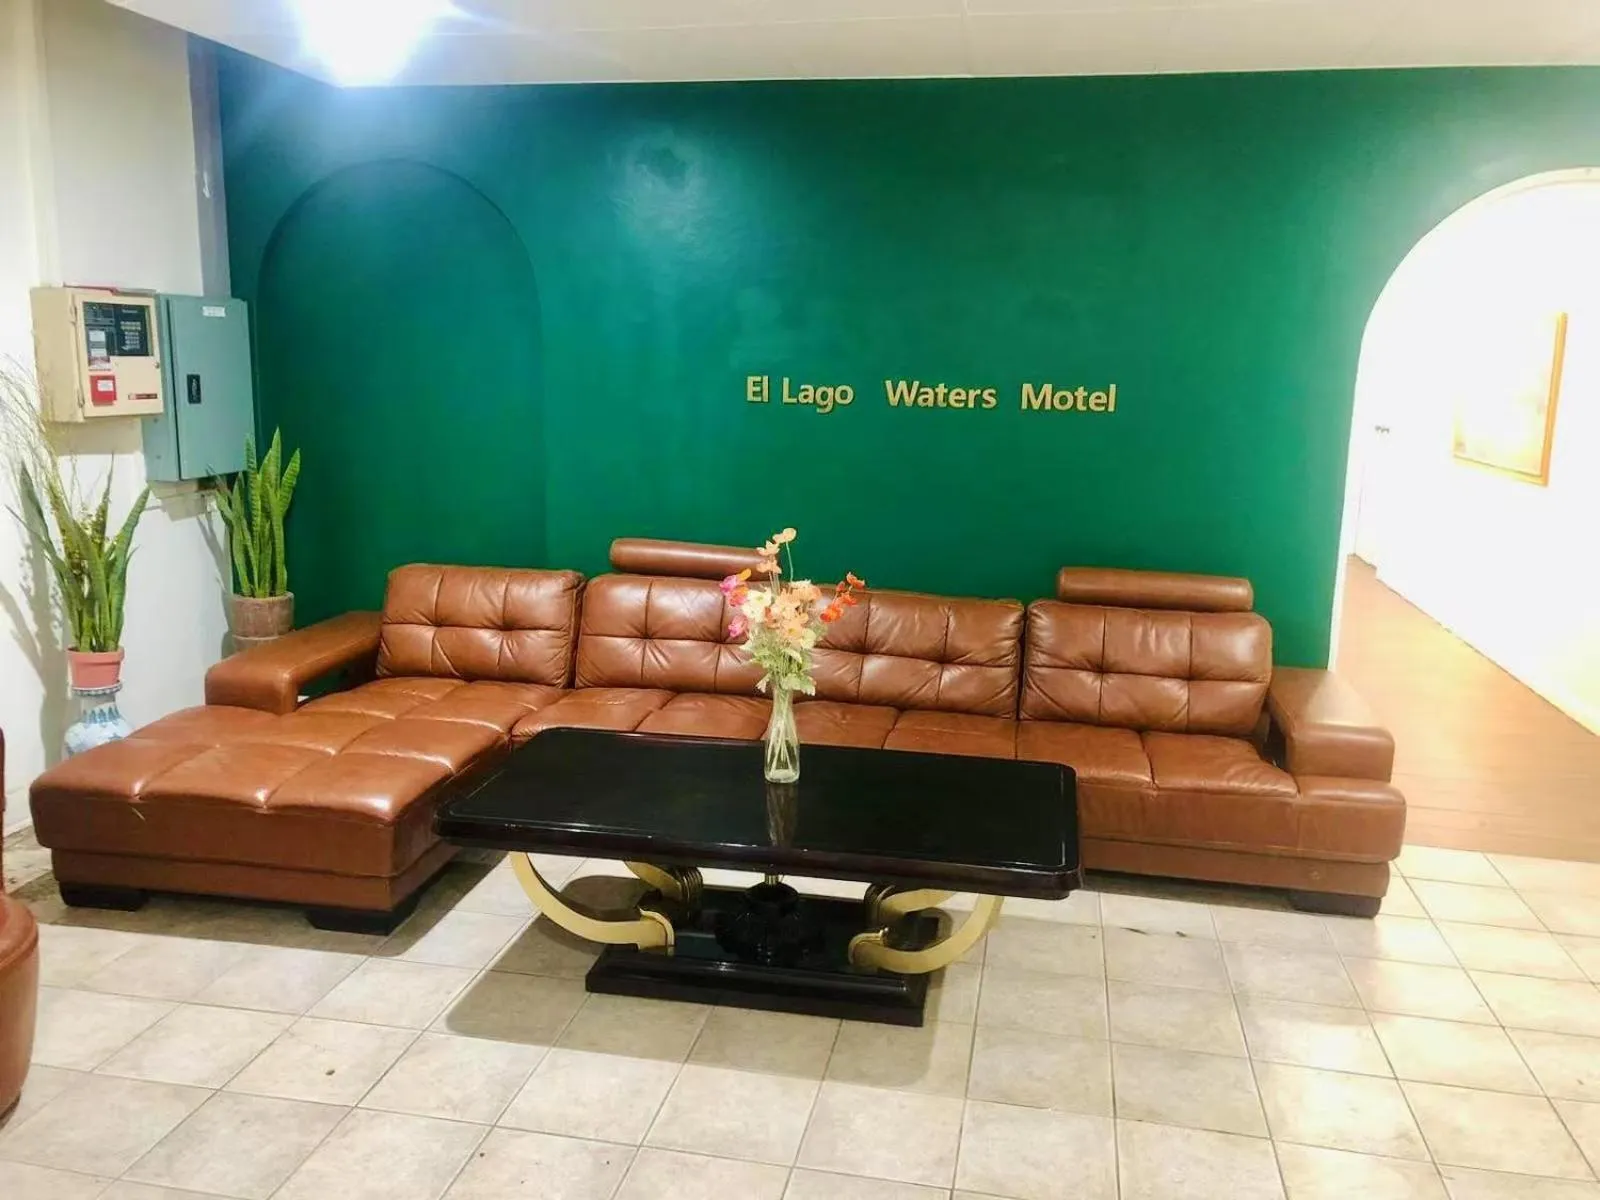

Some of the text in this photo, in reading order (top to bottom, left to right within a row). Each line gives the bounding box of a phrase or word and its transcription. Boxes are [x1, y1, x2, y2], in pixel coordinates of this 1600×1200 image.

[747, 375, 1116, 413] El Lago Waters Motel
